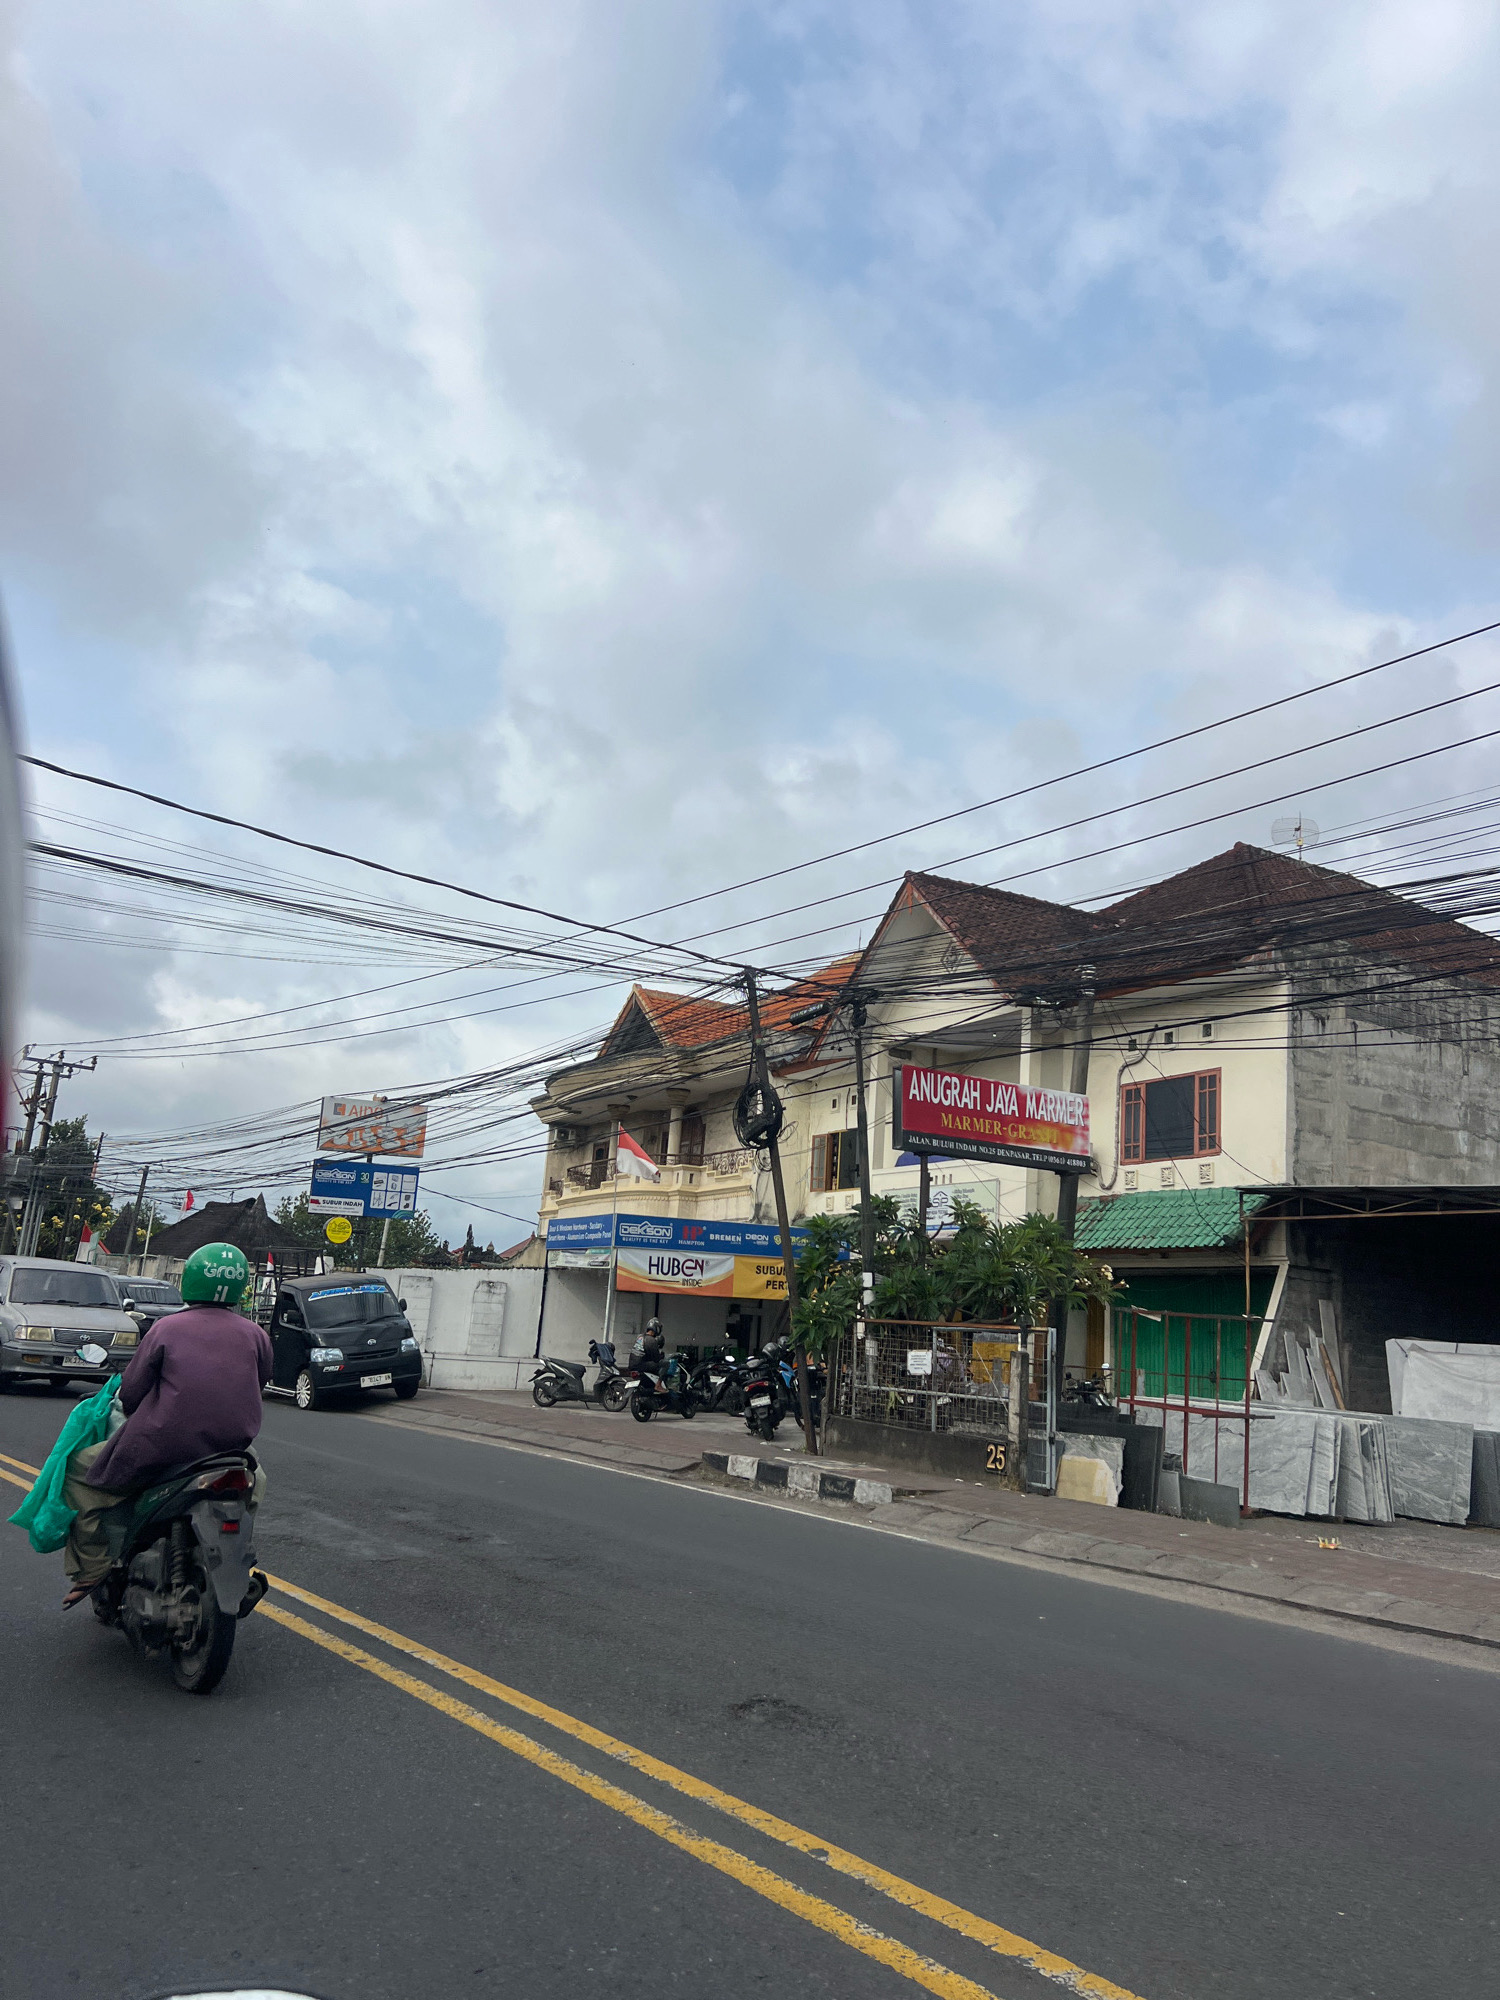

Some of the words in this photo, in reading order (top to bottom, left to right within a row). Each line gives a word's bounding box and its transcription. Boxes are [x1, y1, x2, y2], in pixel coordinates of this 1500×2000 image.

[908, 1069, 981, 1111] ANUGRAH
[985, 1082, 1019, 1118] JAYA
[1025, 1090, 1085, 1127] MARMER
[932, 1138, 955, 1149] BULUH
[955, 1141, 977, 1153] INDAH
[978, 1145, 996, 1155] NO.25
[342, 1200, 363, 1208] INDAH
[709, 1233, 742, 1242] BREMEN
[203, 1262, 245, 1281] Grab
[648, 1255, 705, 1278] HUBEN
[681, 1277, 703, 1288] INSIDE
[986, 1443, 1005, 1470] 25
